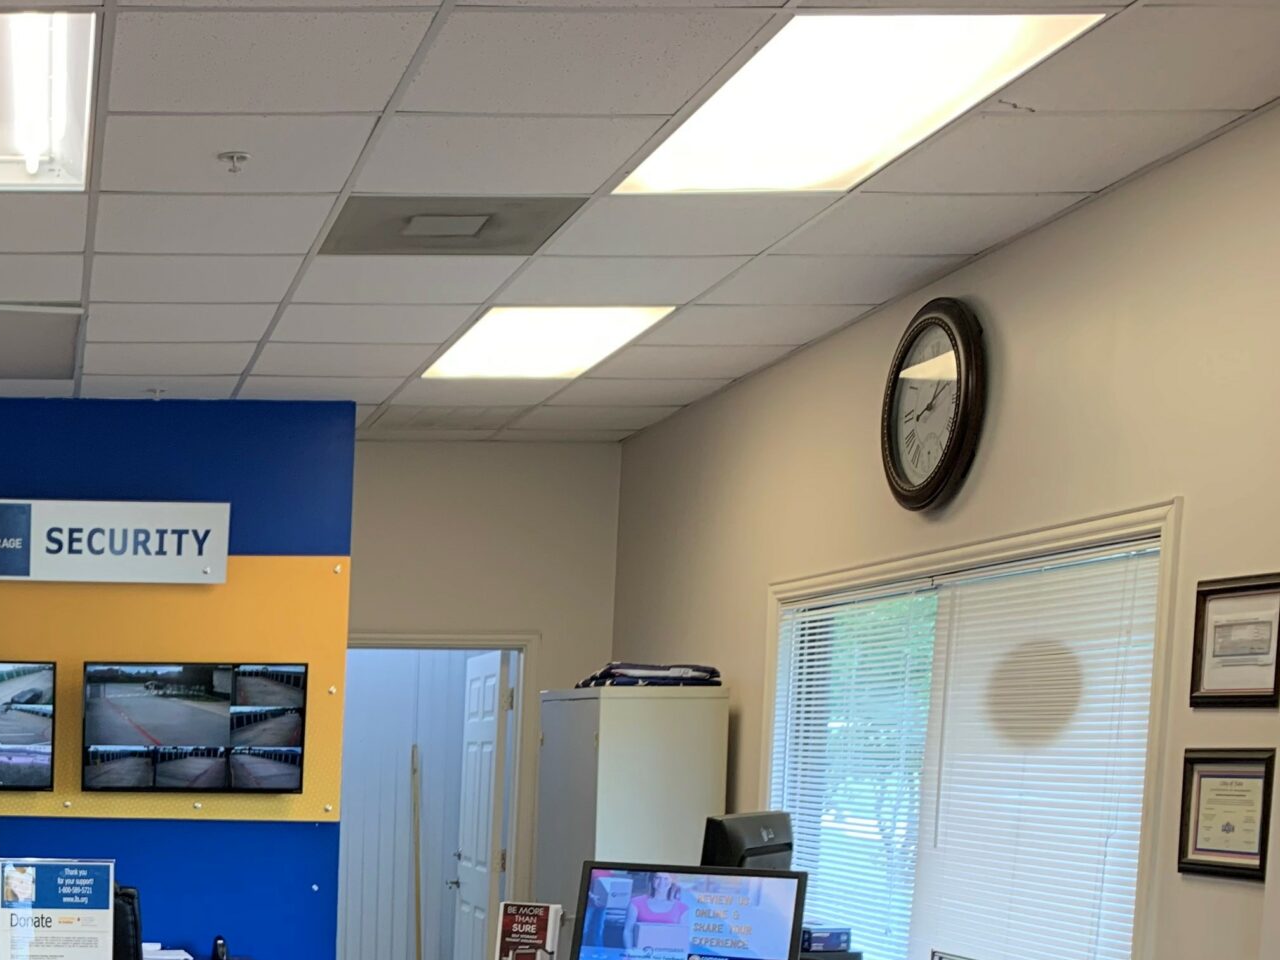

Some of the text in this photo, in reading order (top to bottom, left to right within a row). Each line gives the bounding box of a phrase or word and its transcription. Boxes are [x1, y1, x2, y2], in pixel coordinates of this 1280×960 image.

[45, 527, 211, 556] SECURITY
[508, 906, 544, 916] BE MORE
[10, 913, 52, 928] Donate
[515, 915, 537, 923] THAN
[512, 923, 537, 933] SURE
